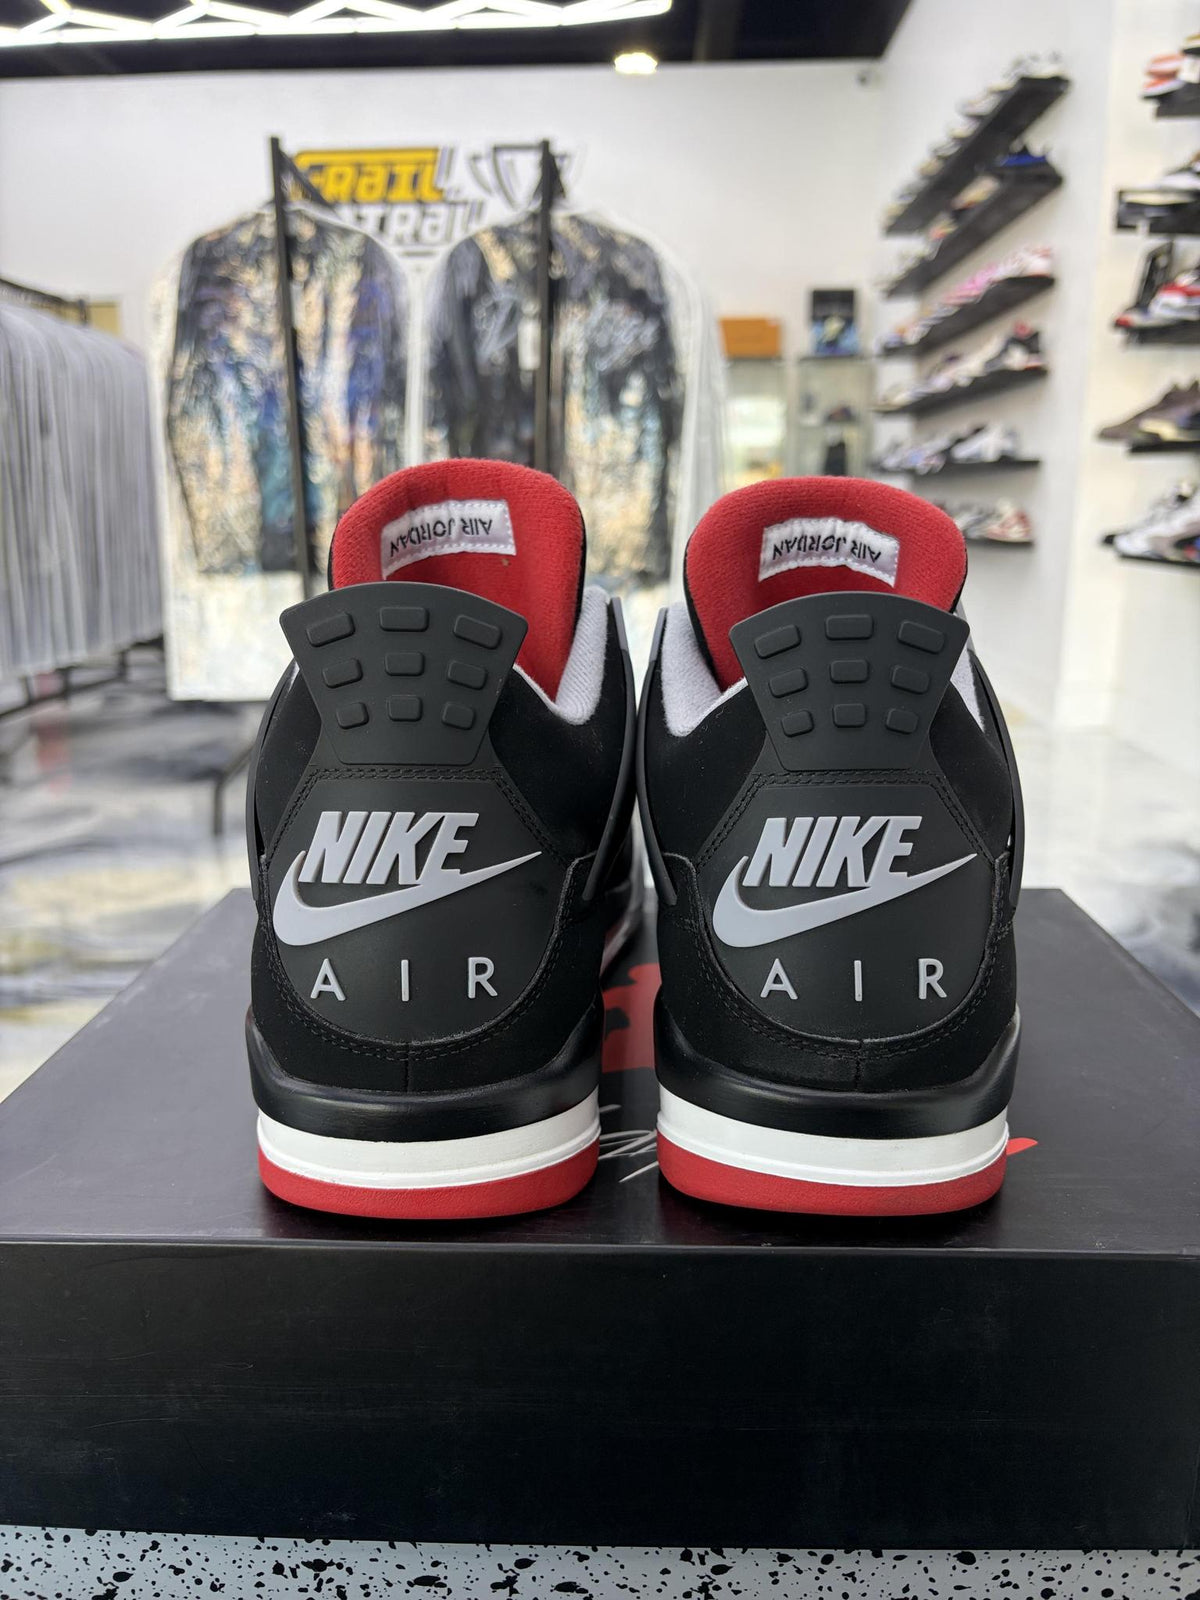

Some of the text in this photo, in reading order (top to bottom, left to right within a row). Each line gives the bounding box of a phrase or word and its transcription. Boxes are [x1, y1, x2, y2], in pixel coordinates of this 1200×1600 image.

[389, 518, 493, 557] AIR JORDAN
[772, 535, 882, 563] AIR JORDAN
[298, 811, 479, 885] NIKE
[742, 815, 922, 888] NIKE
[310, 956, 498, 1002] AIR
[760, 957, 948, 1002] AIR
